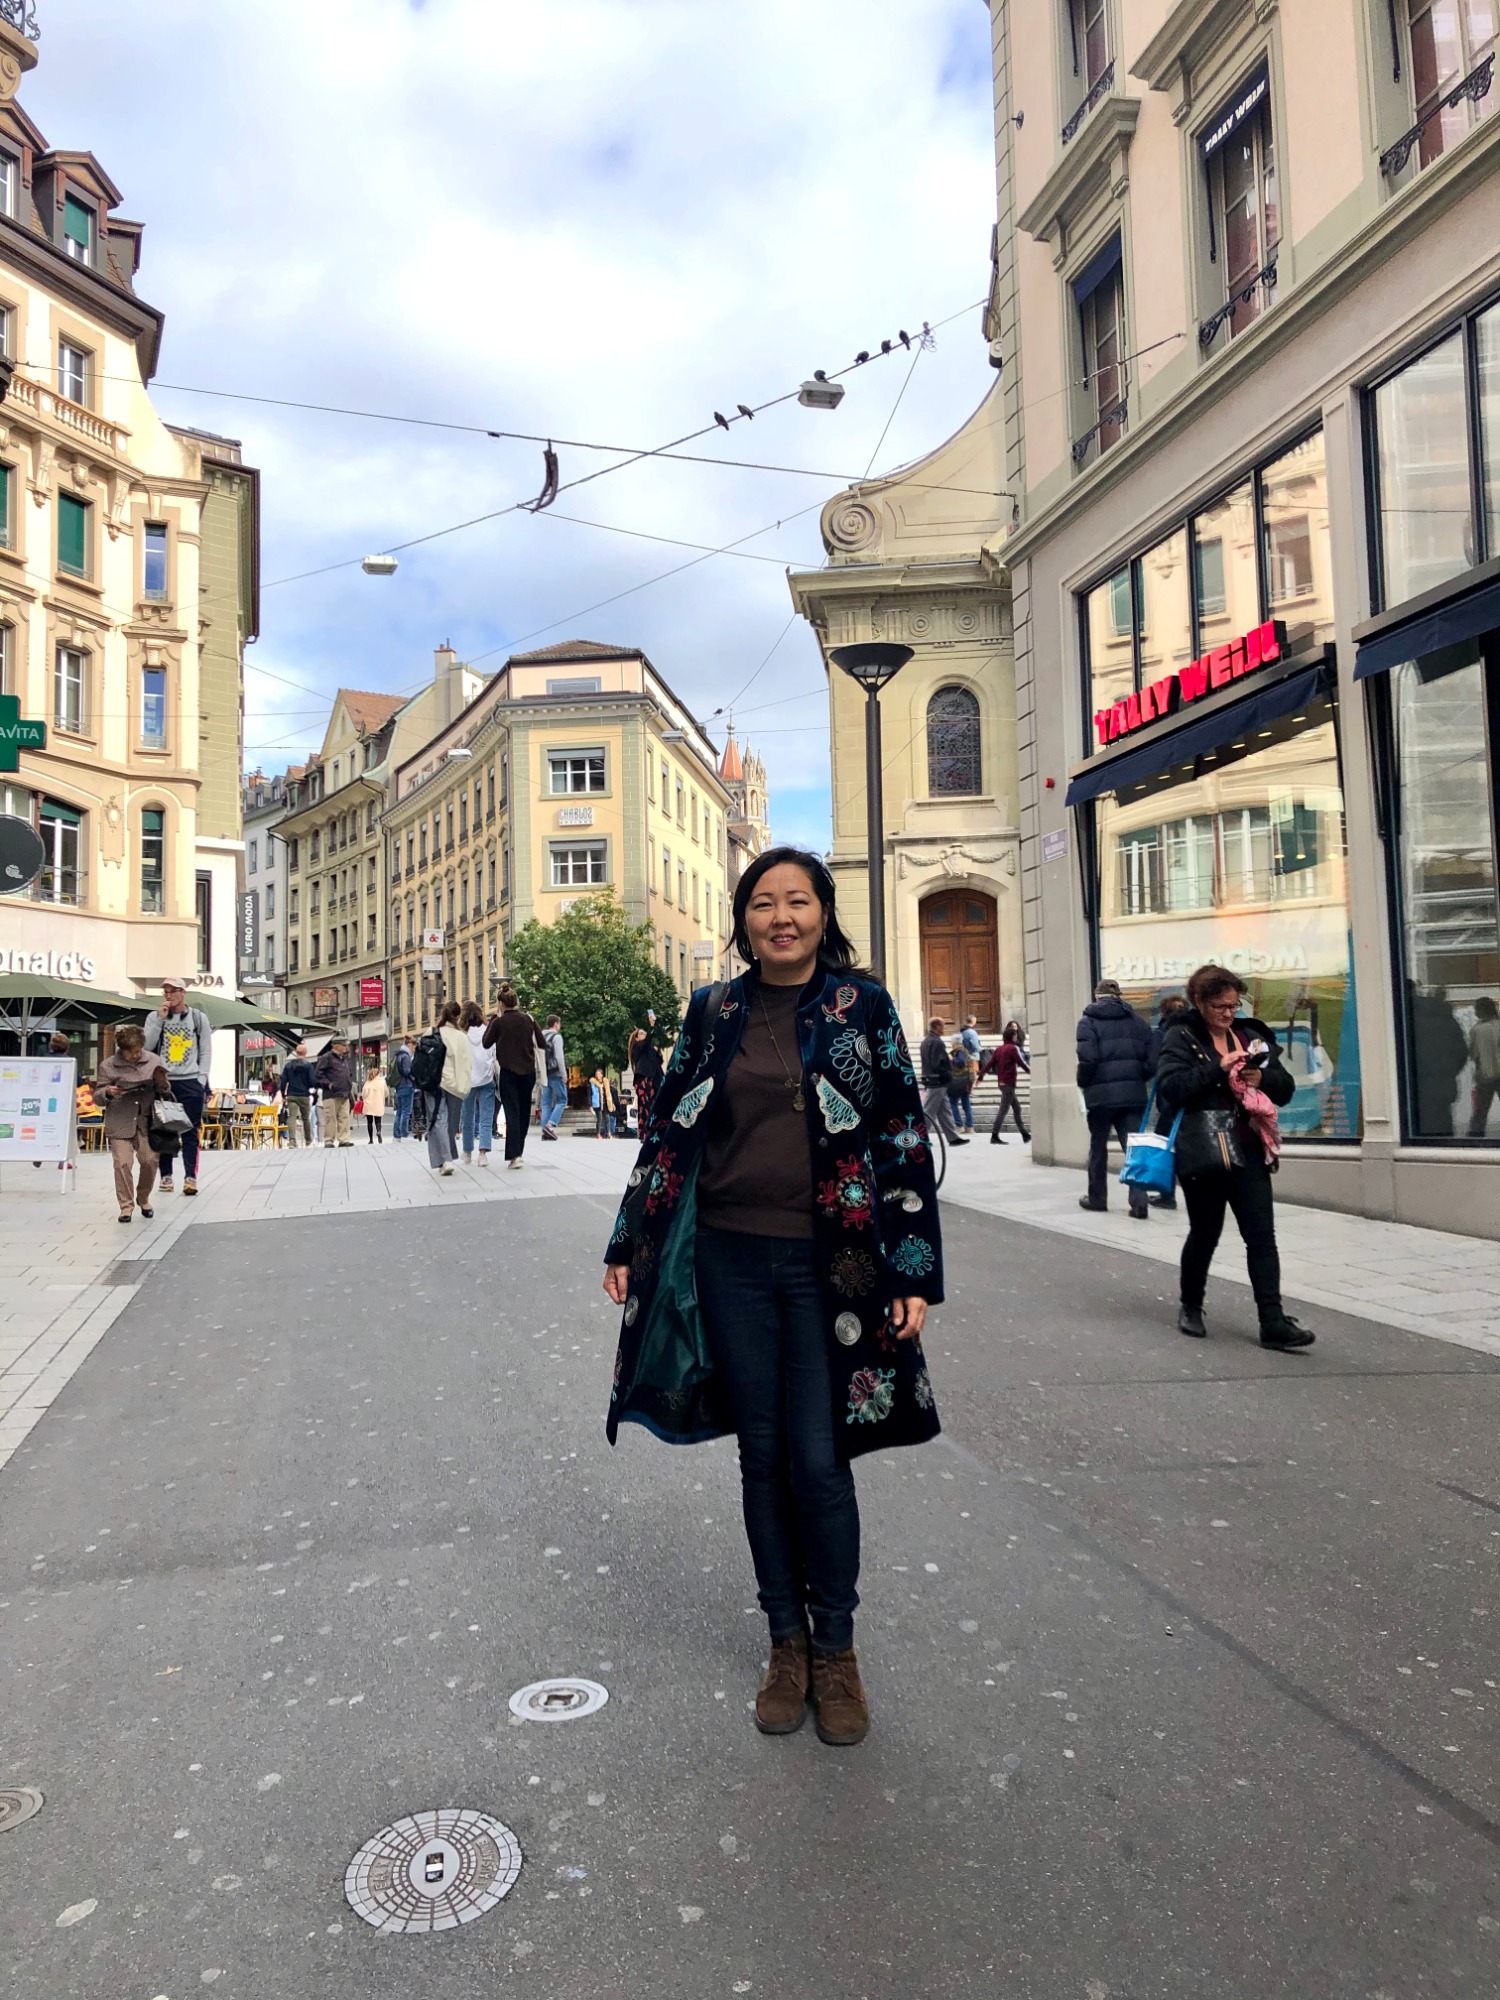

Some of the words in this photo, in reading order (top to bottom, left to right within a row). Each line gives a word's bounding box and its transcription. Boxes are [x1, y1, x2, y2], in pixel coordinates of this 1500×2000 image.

[1205, 113, 1234, 153] TALLY
[1094, 675, 1174, 745] TALLY
[244, 895, 253, 925] MODA
[244, 926, 253, 954] VERO
